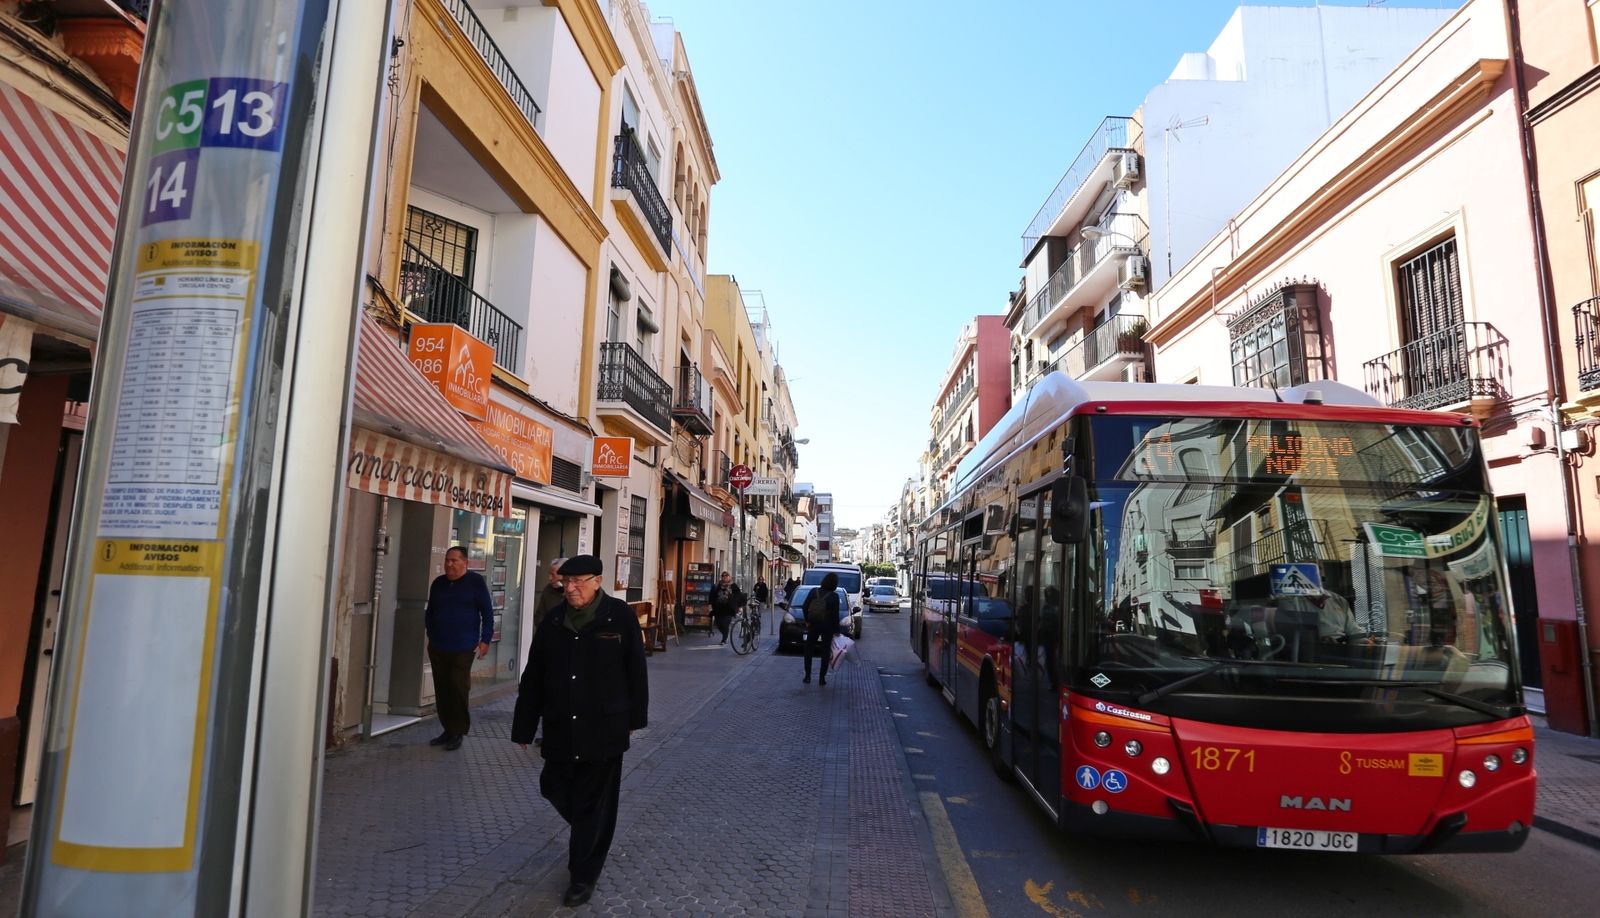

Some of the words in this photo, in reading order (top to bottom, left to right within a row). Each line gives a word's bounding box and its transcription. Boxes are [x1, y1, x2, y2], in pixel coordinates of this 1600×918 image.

[155, 89, 205, 140] C5
[212, 88, 275, 138] 13
[148, 161, 188, 213] 14
[184, 249, 218, 257] AVISOS
[415, 337, 445, 353] 954
[414, 358, 443, 374] 086
[485, 404, 551, 448] INMOBILIARIA
[1143, 432, 1174, 471] 14
[347, 450, 454, 494] nmarcación
[511, 450, 525, 474] 65
[528, 455, 541, 479] 75
[1265, 456, 1339, 476] NORTE
[129, 543, 199, 553] INFORMACIÓN
[144, 553, 180, 562] AVISOS
[1106, 705, 1152, 721] Castrosua
[1191, 746, 1256, 773] 1871
[1355, 758, 1406, 769] TUSSAM
[1280, 795, 1351, 811] MAN
[1271, 829, 1314, 847] 1820
[1320, 833, 1354, 849] JGC
